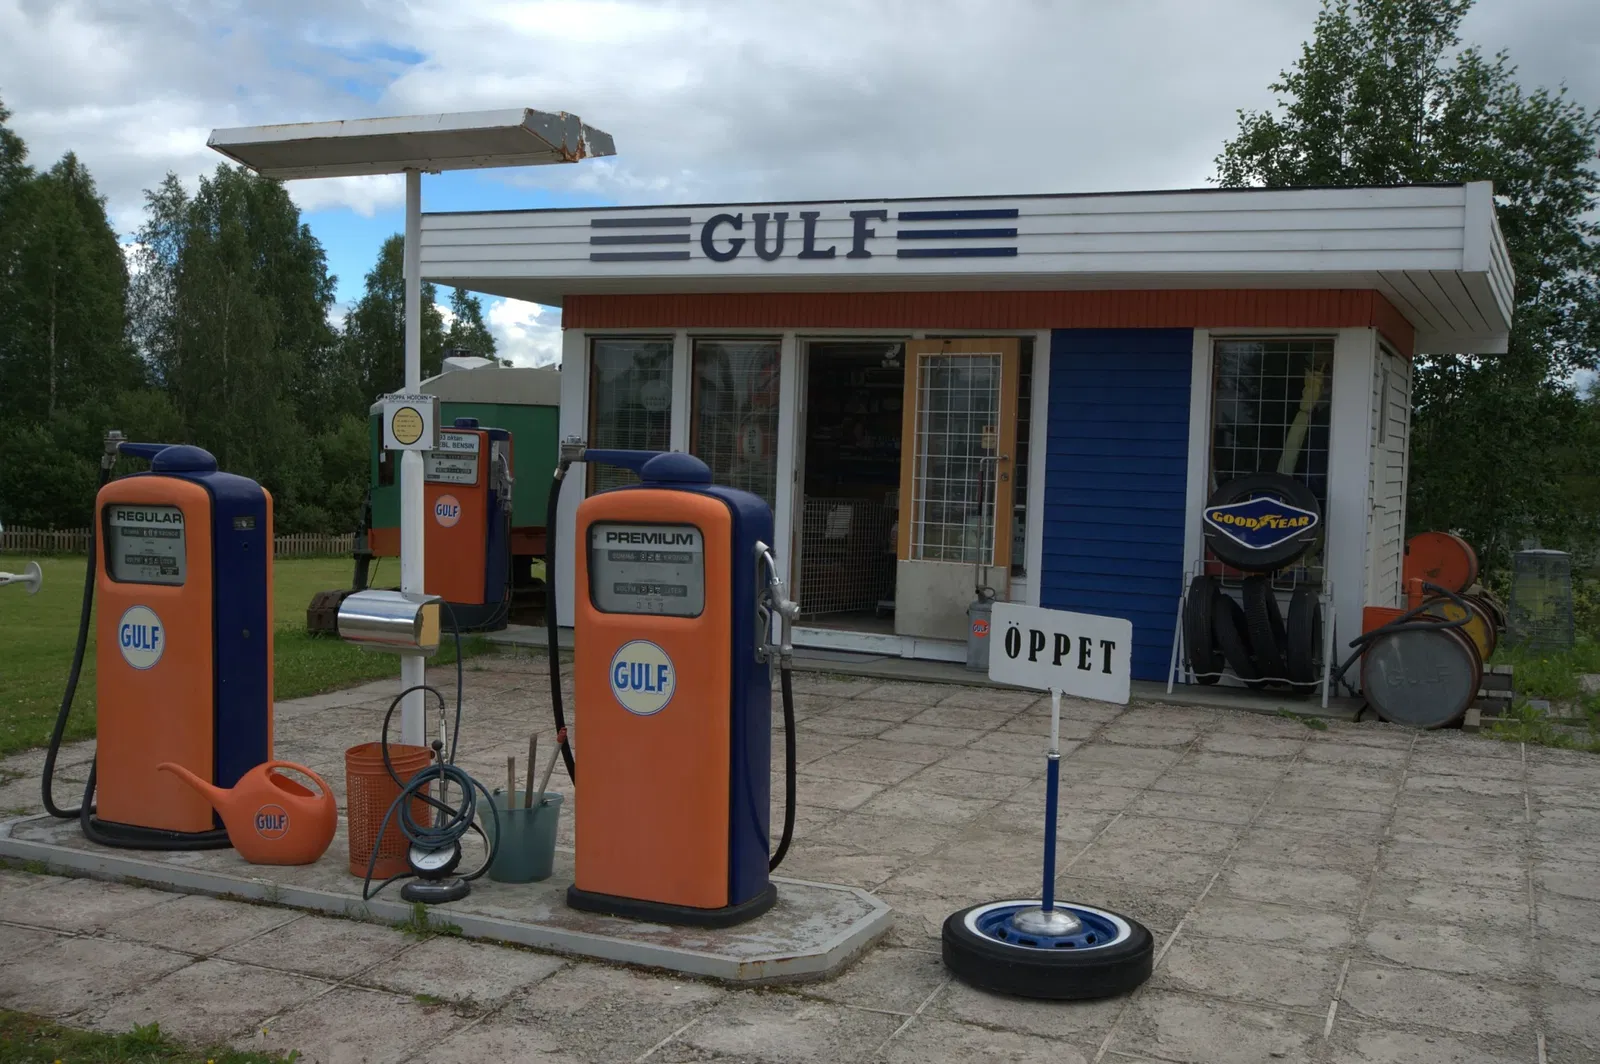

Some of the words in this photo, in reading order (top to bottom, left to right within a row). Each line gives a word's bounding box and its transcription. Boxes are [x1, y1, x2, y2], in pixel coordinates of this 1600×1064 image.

[700, 209, 888, 262] GULF
[452, 441, 475, 449] BENSIN
[116, 510, 182, 524] REGULAR
[436, 503, 458, 517] GULF
[606, 531, 693, 546] PREMIUM
[972, 624, 989, 632] GULF
[121, 623, 160, 651] GULF
[1005, 620, 1116, 675] ÖPPET
[614, 661, 669, 694] GULF
[256, 814, 286, 830] GULF
